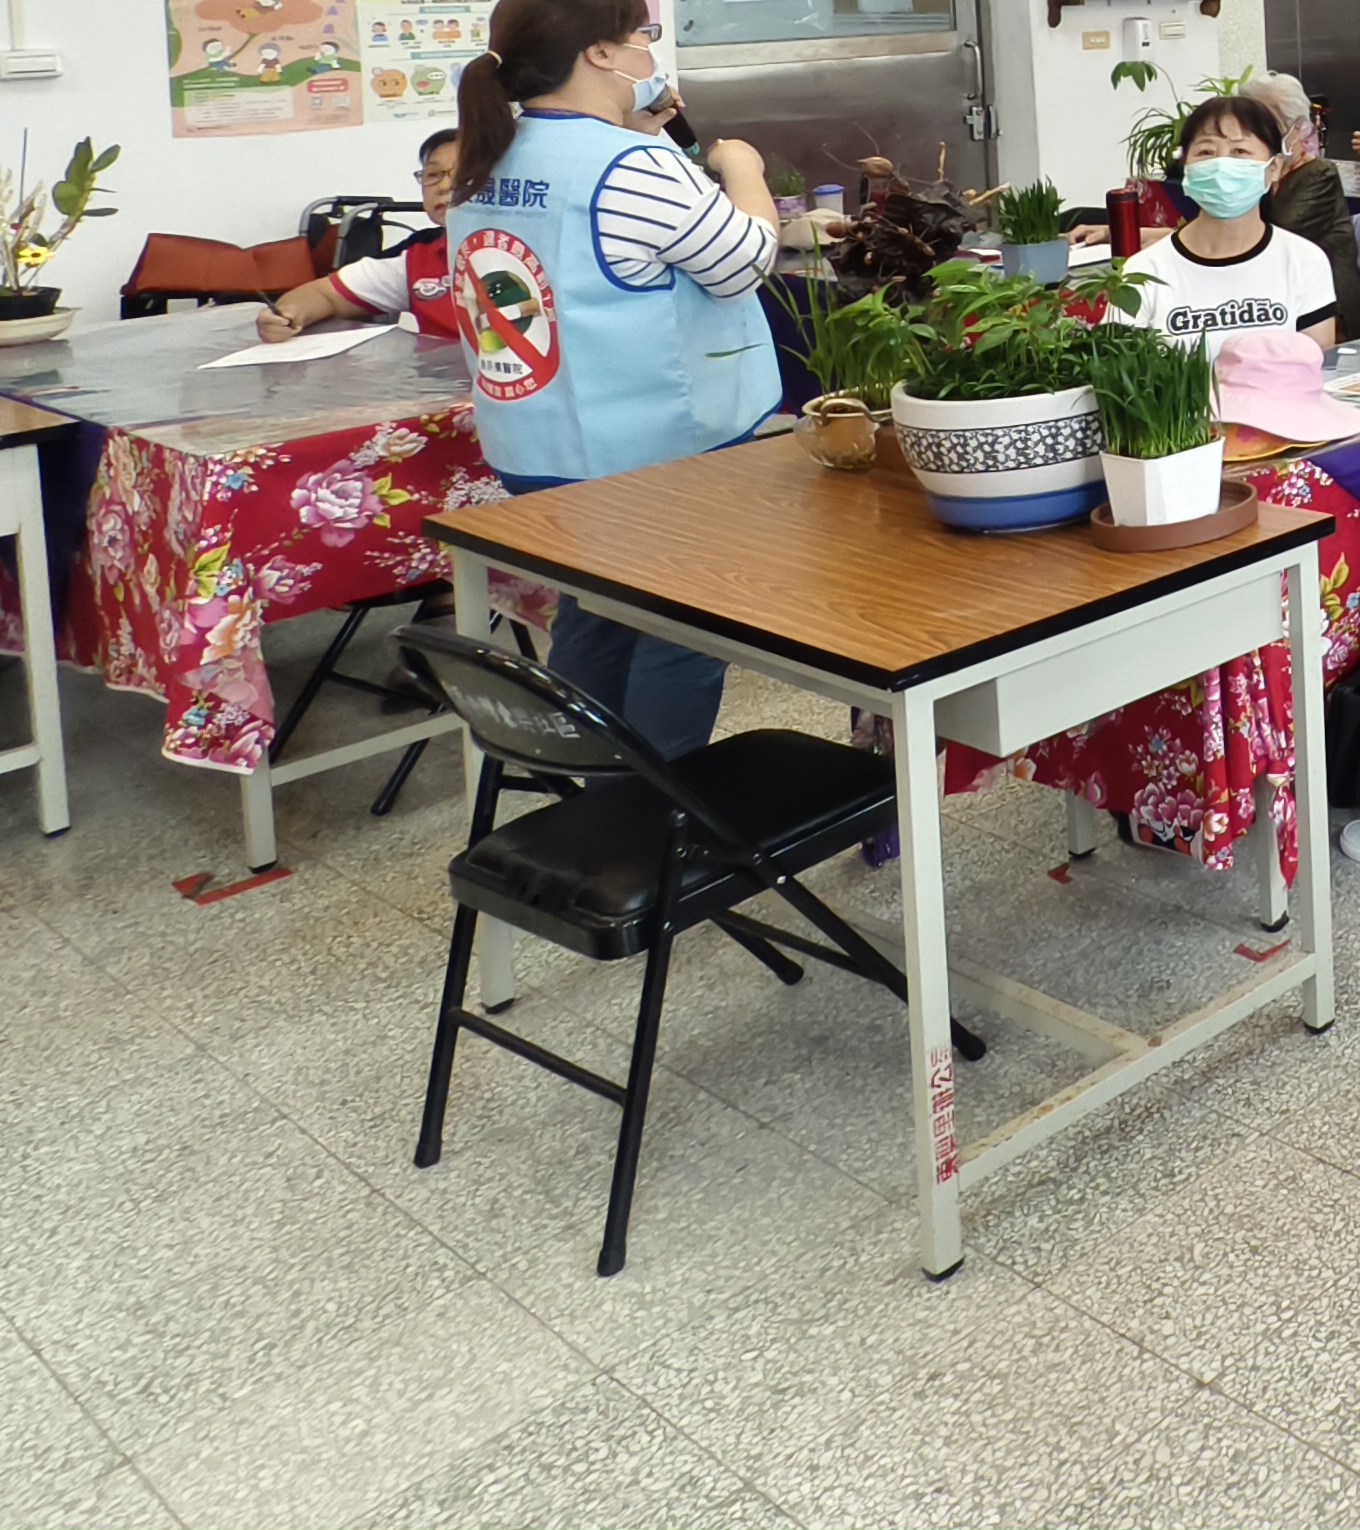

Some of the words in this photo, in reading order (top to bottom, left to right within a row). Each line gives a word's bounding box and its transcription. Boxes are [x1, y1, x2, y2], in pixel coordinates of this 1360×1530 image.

[469, 176, 550, 210] 晟醫院
[1170, 299, 1286, 333] Gratidão
